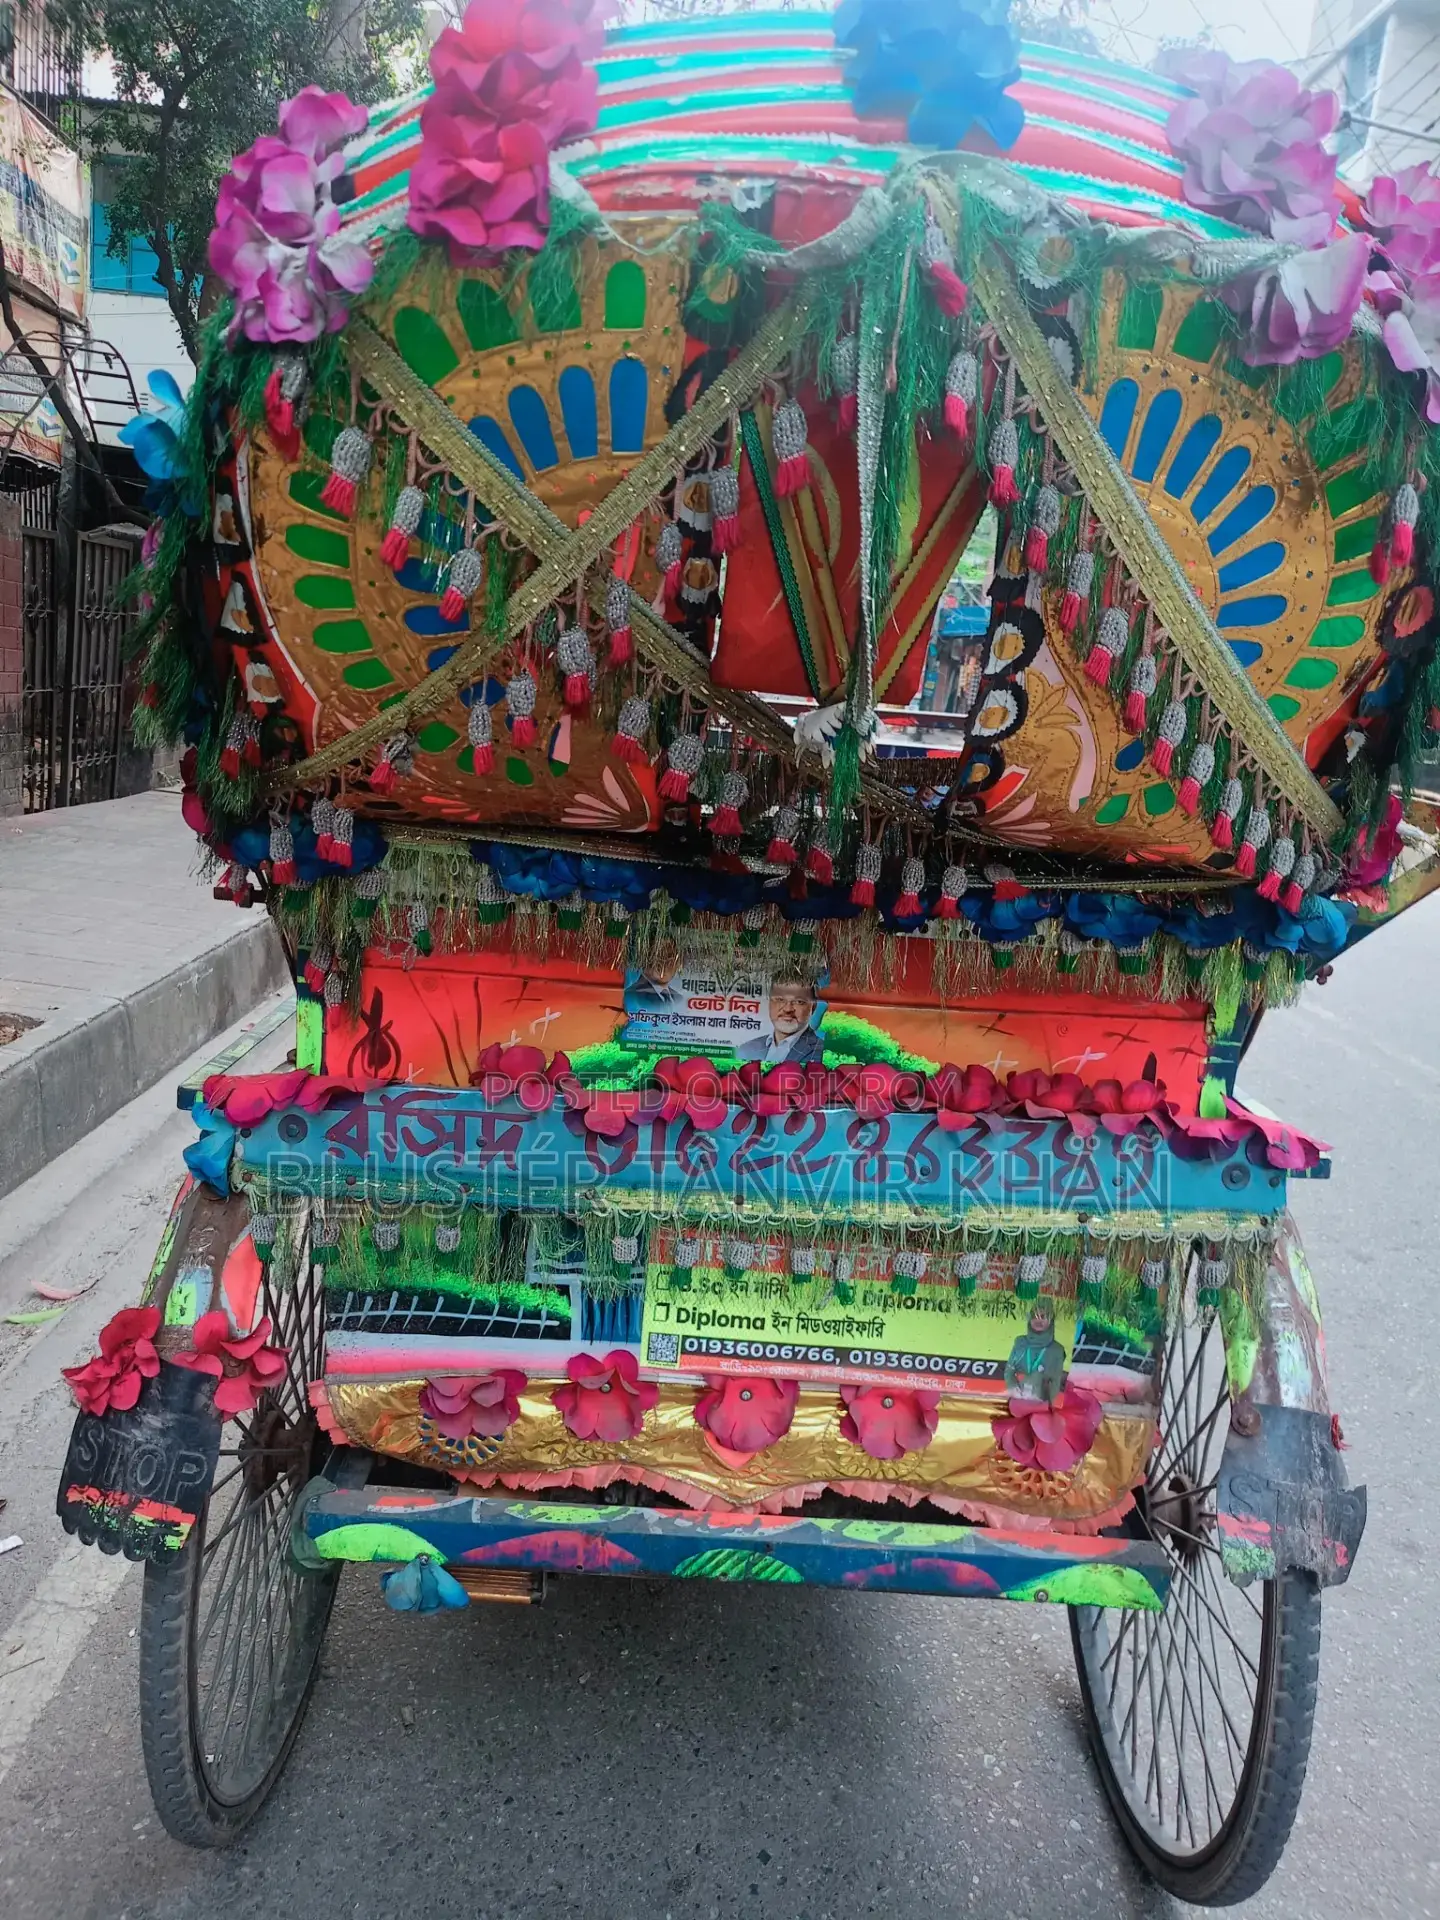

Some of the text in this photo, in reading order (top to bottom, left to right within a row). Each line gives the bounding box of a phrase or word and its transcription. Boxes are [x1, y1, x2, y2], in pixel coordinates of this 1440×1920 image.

[682, 978, 717, 994] ধানের
[687, 995, 761, 1014] ভোট দিন
[628, 1009, 761, 1031] শফিকুল ইসলাম খান মিল্টন
[863, 1288, 950, 1313] Diploma
[676, 1307, 885, 1338] Diploma ইন মিডওয়াইফারি
[684, 1337, 841, 1366] 01936006766,
[848, 1349, 999, 1376] 01936006767
[76, 1417, 207, 1504] STOP
